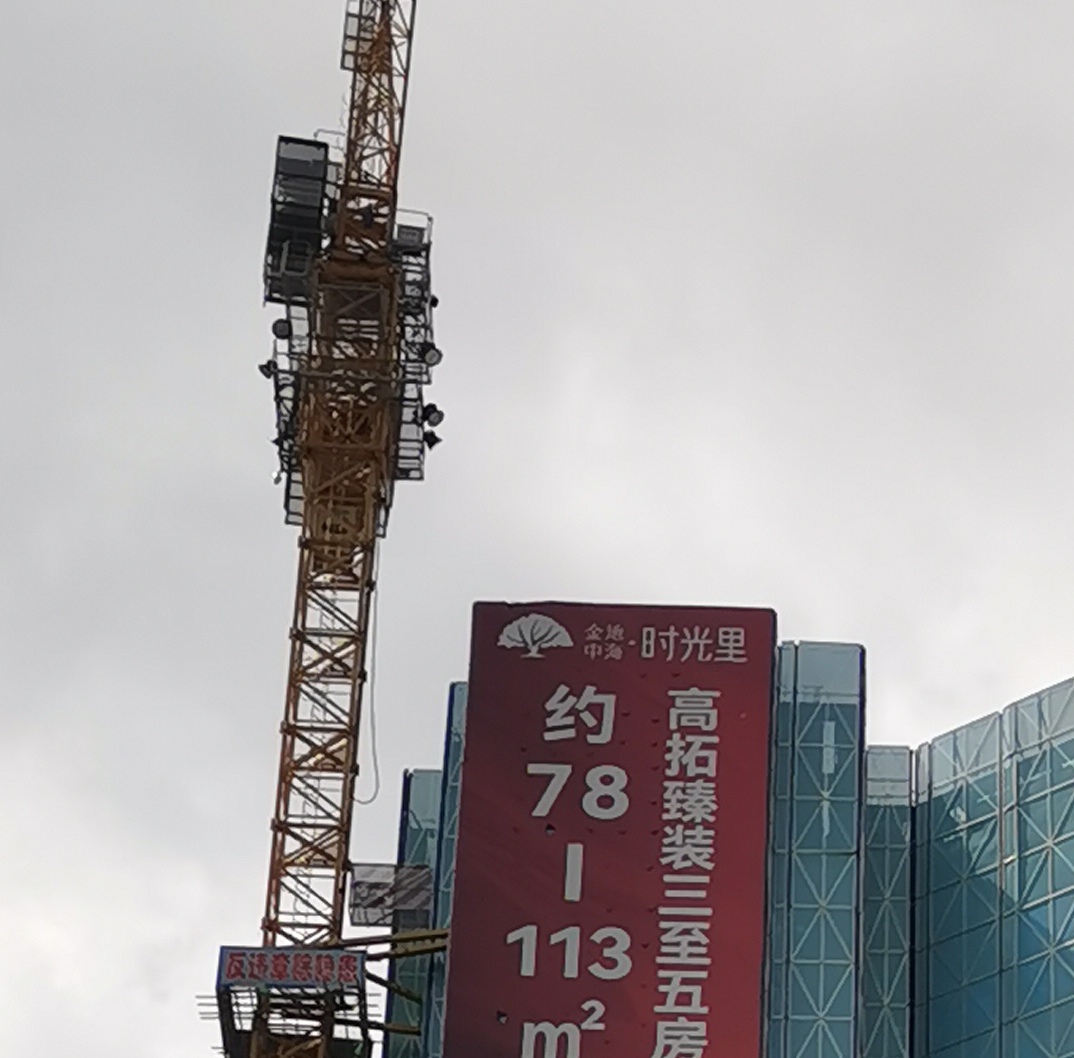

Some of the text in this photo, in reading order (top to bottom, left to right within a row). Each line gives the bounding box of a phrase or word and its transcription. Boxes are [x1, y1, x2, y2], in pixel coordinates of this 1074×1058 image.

[641, 625, 748, 663] 时光里
[543, 684, 617, 744] 约
[526, 763, 630, 820] 78
[505, 925, 632, 980] 113
